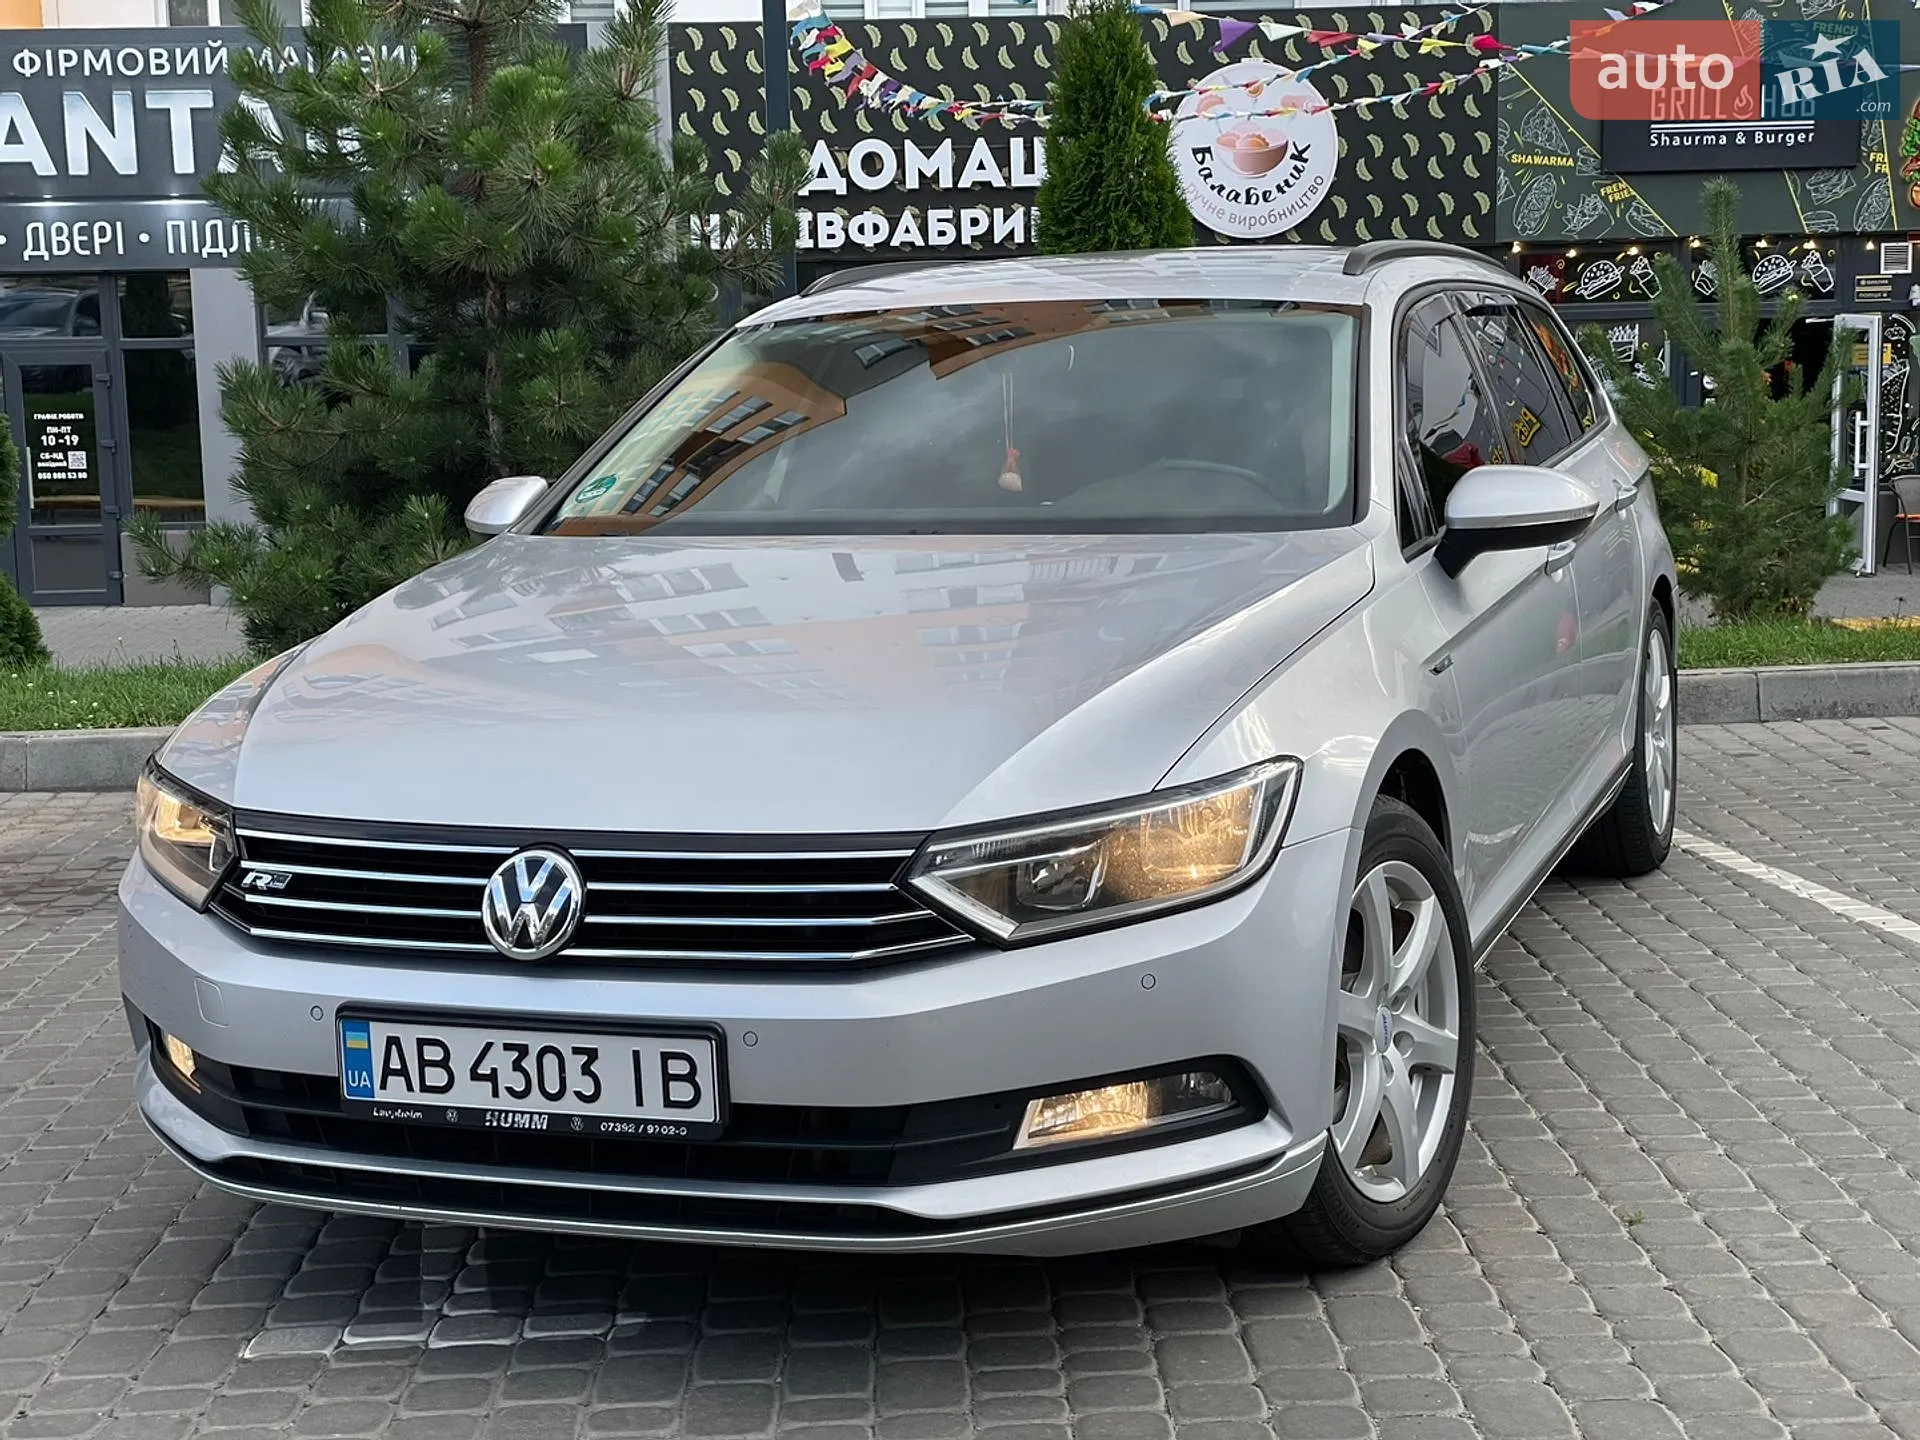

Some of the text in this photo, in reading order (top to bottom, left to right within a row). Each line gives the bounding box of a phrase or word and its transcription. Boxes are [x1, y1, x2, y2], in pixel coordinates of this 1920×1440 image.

[13, 40, 229, 77] ФІРМОВИЙ
[1650, 86, 1727, 121] GRILL
[1650, 131, 1815, 147] Shaurma & Burger
[1511, 153, 1575, 167] SHAWARMA
[1228, 175, 1324, 231] виробництво
[23, 221, 123, 261] ДВЕРІ
[348, 1071, 372, 1089] UA
[379, 1035, 702, 1109] AB 4303 IB
